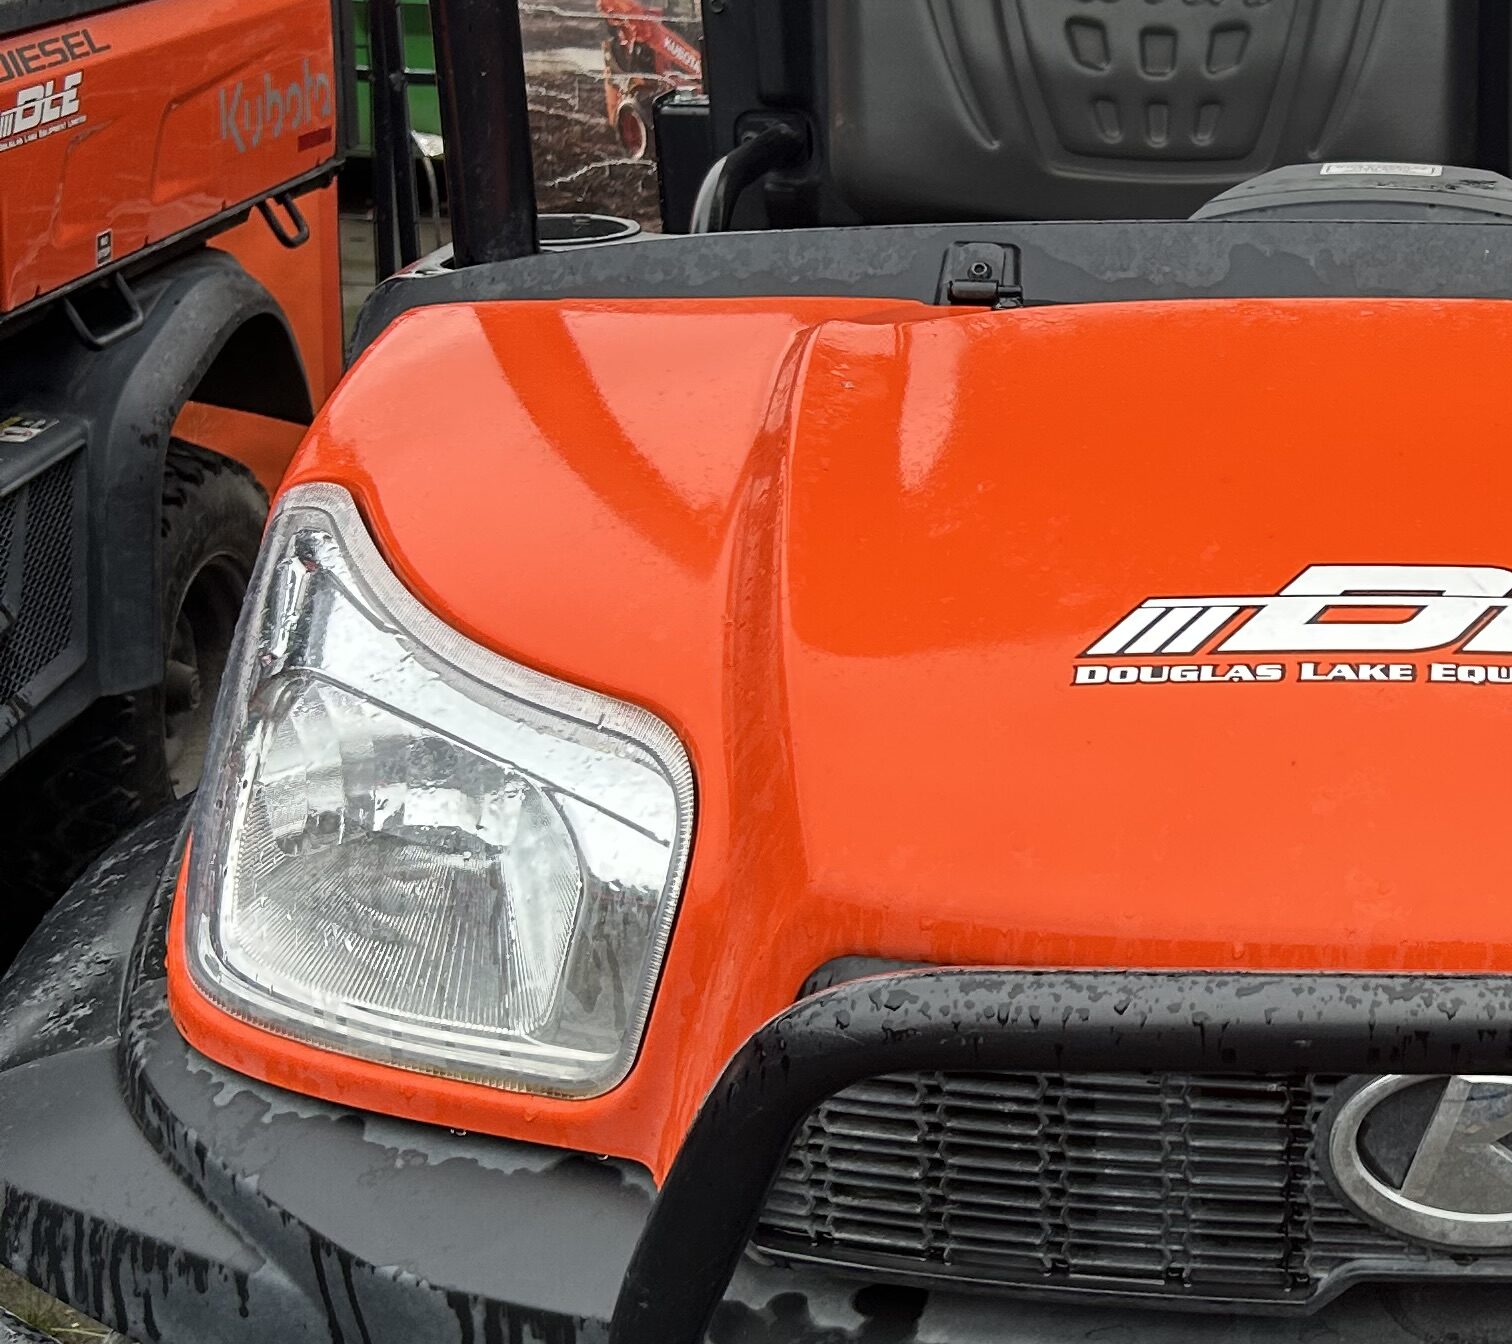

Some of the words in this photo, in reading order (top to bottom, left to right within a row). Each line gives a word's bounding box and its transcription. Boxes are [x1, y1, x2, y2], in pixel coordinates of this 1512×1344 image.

[218, 56, 332, 154] Kubota
[1075, 663, 1284, 685] DOUGLAS
[1299, 662, 1415, 682] LAKE
